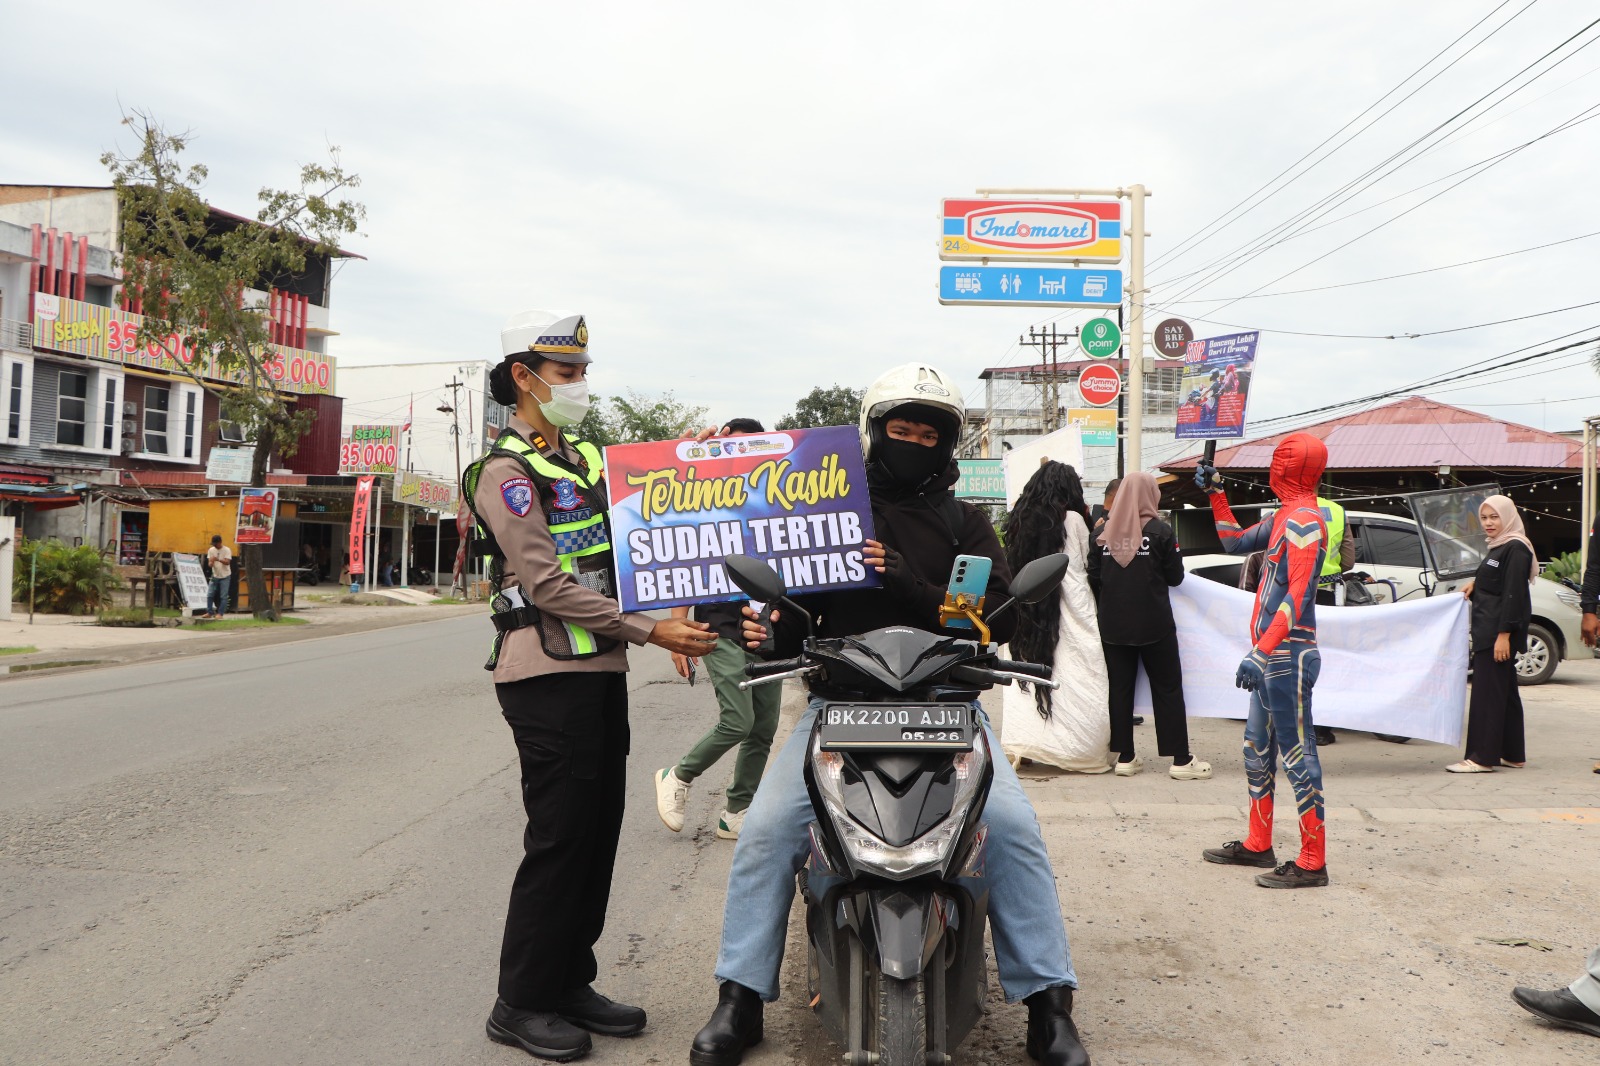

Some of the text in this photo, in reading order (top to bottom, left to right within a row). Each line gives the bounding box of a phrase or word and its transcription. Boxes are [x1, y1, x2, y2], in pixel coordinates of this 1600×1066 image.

[975, 216, 1089, 238] Indomaret
[944, 240, 961, 251] 24
[54, 318, 100, 342] SERBA
[1164, 325, 1184, 334] SAY
[1165, 333, 1185, 342] BRE
[1237, 334, 1255, 344] Lebih
[1164, 341, 1179, 349] AD
[1083, 377, 1117, 388] Yummy
[355, 427, 391, 440] SERBA
[976, 466, 999, 475] MAKAN
[627, 453, 850, 521] Terima Kasih
[352, 493, 367, 562] METRO
[628, 511, 864, 565] SUDAH TERTIB
[185, 575, 205, 584] JUS
[920, 709, 961, 725] AJW
